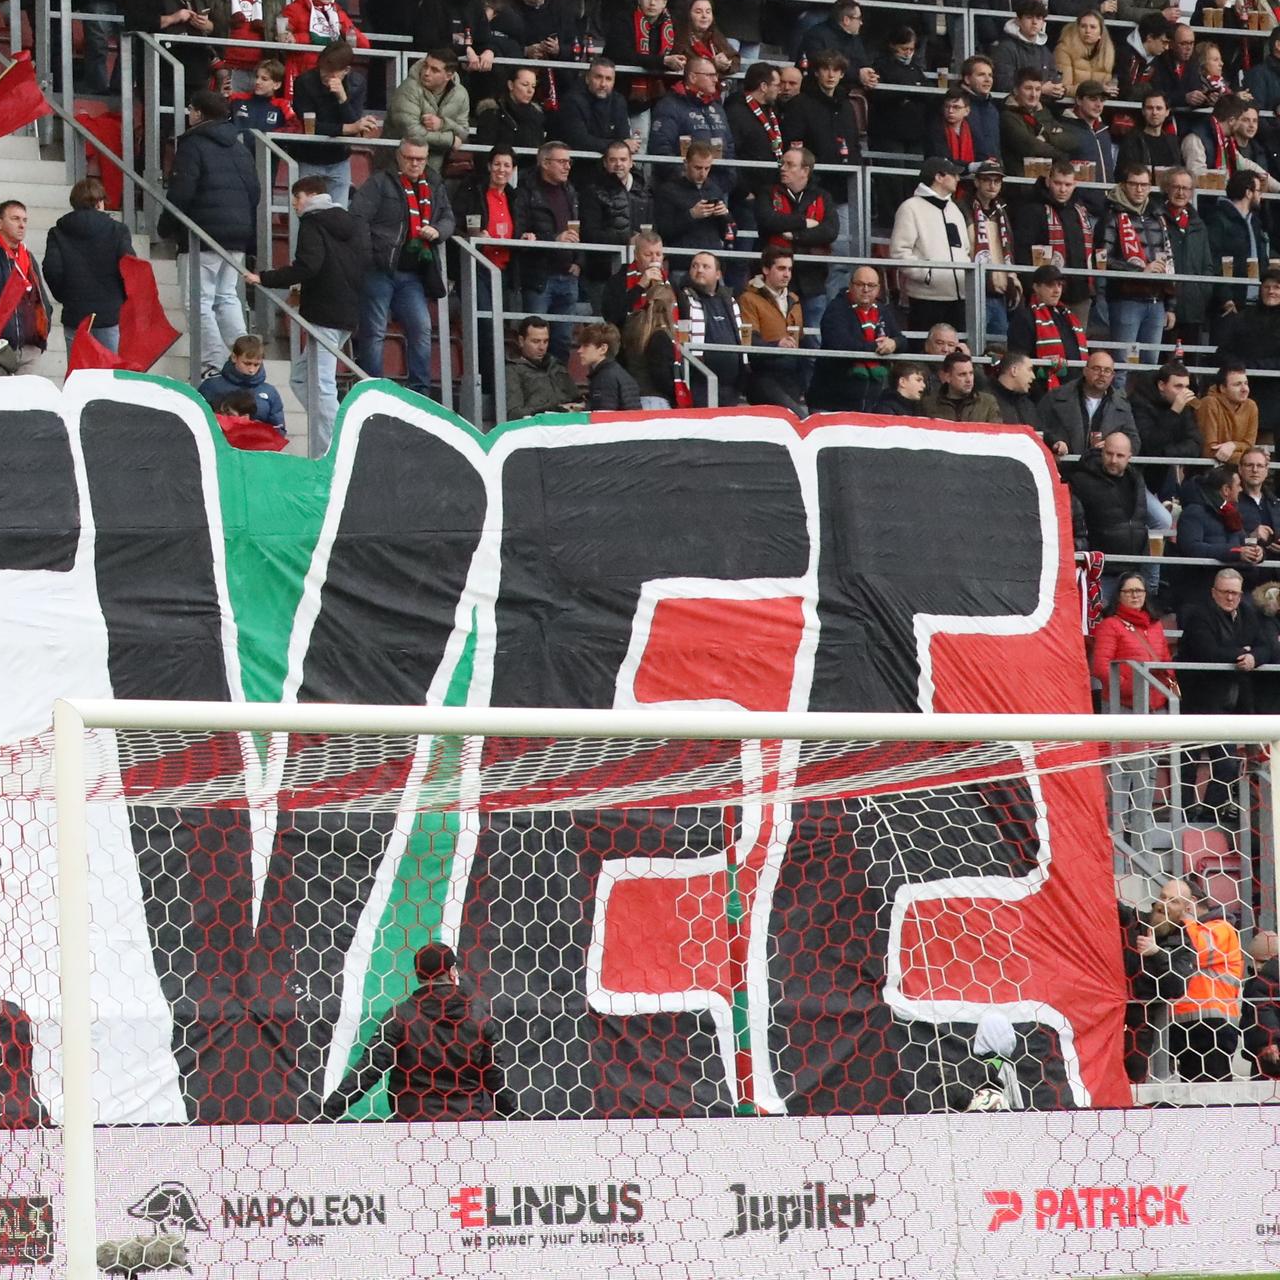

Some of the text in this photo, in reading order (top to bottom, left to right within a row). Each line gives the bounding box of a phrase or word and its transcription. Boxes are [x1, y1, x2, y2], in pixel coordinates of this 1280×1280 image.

[223, 1194, 387, 1228] NAPOLEON
[450, 1184, 643, 1228] ELINDUS
[723, 1182, 876, 1243] Jupiler
[1034, 1184, 1190, 1230] PATRICK
[461, 1229, 645, 1249] we power your business
